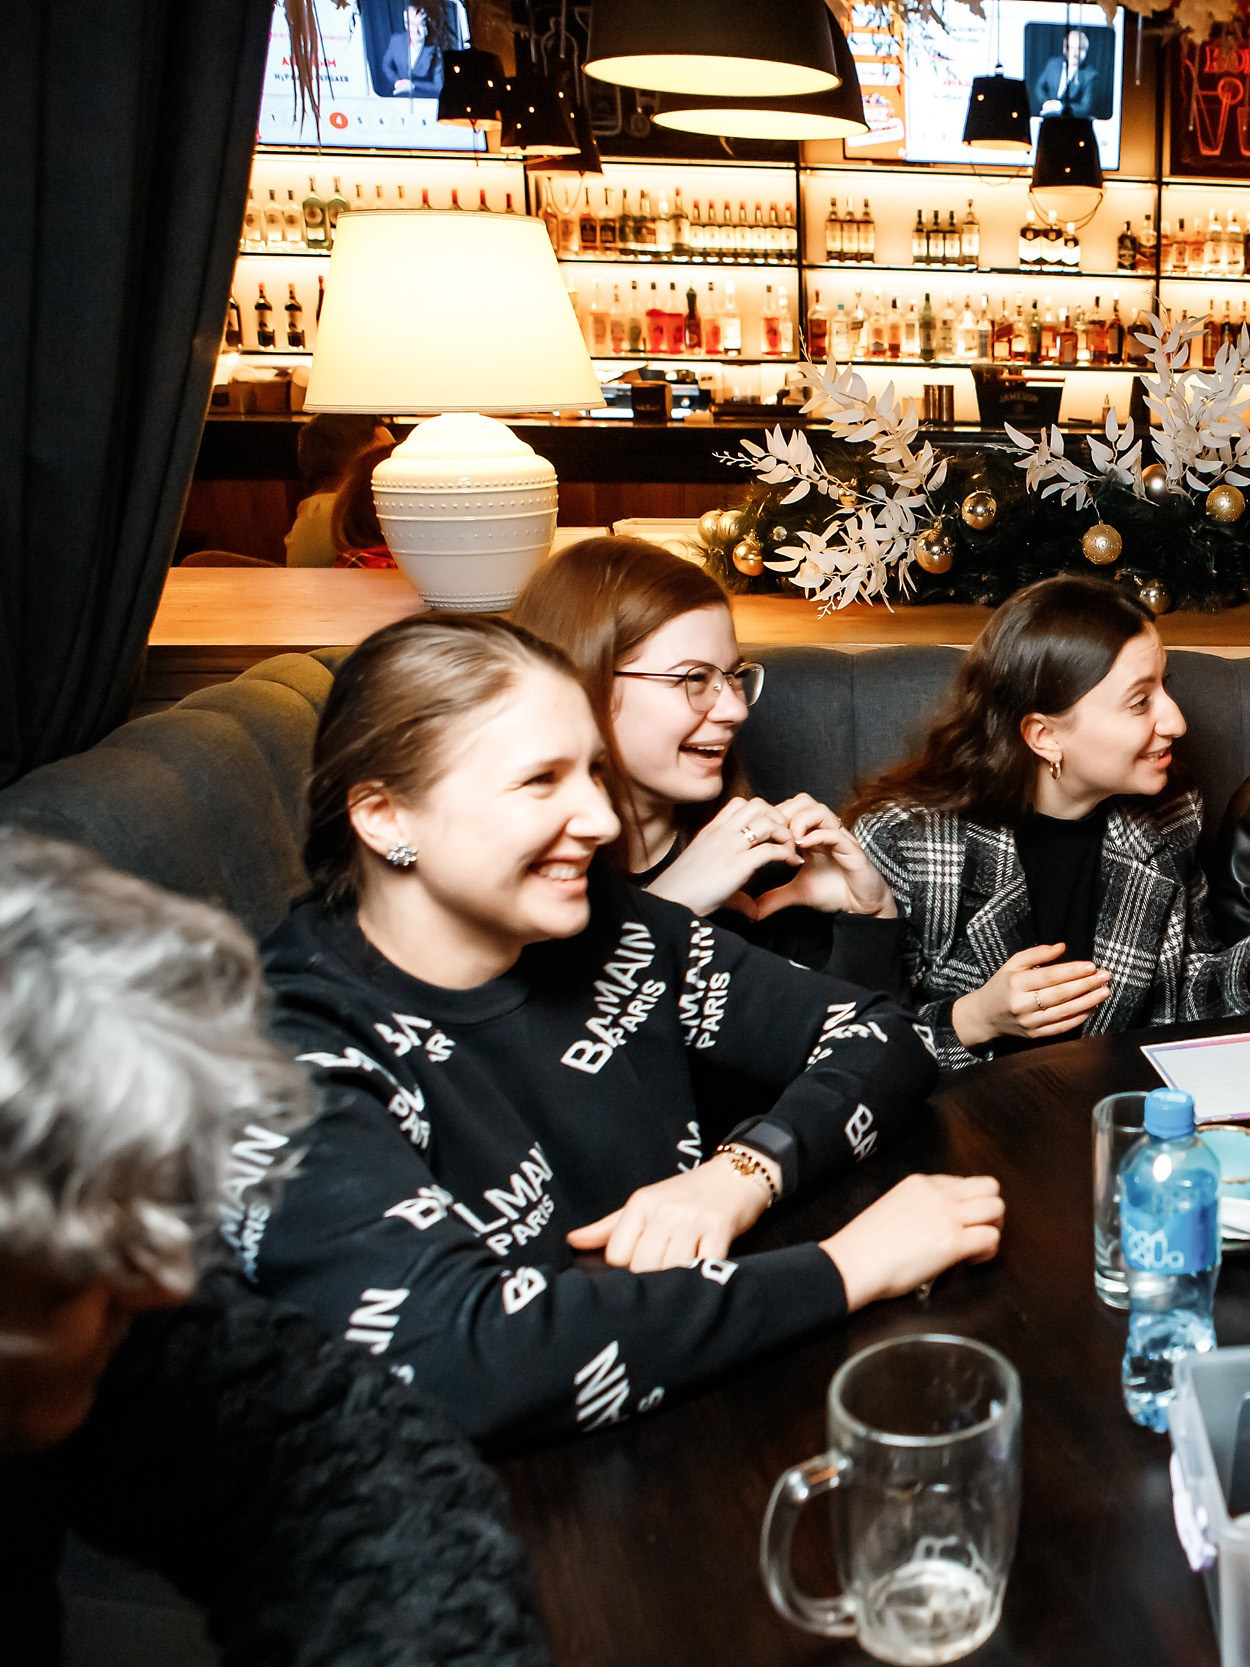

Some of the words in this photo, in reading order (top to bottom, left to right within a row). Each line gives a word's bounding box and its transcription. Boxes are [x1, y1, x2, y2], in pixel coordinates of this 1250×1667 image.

[560, 921, 656, 1074] BAMAIN
[613, 979, 667, 1046] PARIS
[695, 971, 732, 1049] PARIS
[486, 1193, 555, 1256] PARIS
